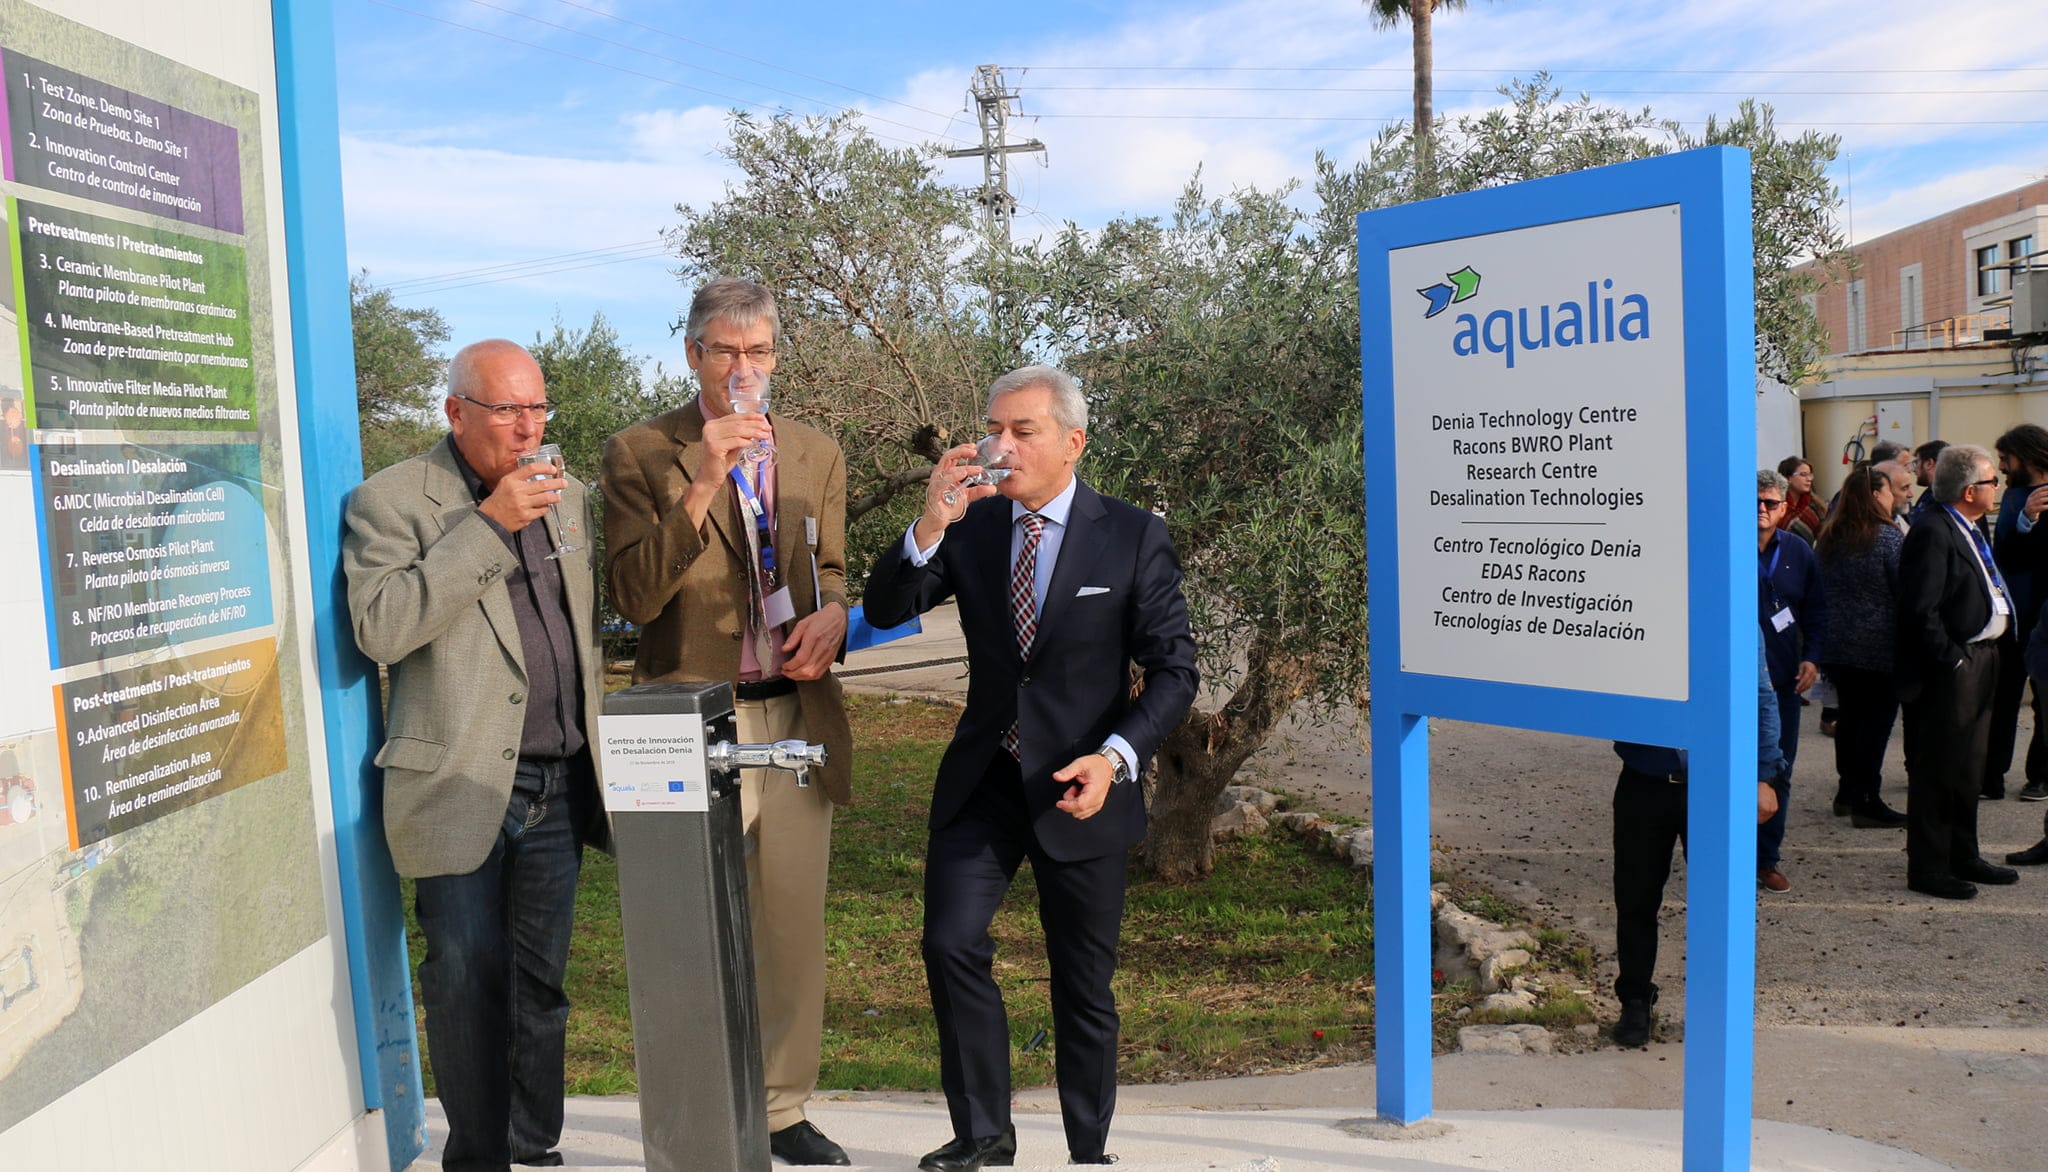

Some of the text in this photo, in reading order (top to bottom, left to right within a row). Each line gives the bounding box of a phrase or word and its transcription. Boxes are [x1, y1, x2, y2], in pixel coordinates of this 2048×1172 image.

[24, 73, 160, 129] 1. Test Zone. Demo Site 1
[43, 102, 188, 159] Zona de Pruebas. Demo Site 1
[28, 132, 180, 186] 2. Innovation Control Center
[48, 161, 201, 212] Centro de control de innovación
[29, 216, 114, 247] Pretreatments
[123, 237, 203, 265] Pretratamientos
[39, 253, 205, 294] 3. Ceramic Membrane Pilot Plant
[59, 280, 236, 319] Planta piloto de membranas cerámicas
[45, 313, 234, 347] 4. Membrane-Based Pretreatment Hub
[1452, 278, 1650, 368] aqualia
[63, 338, 248, 369] Zona de pre-tratamiento por membranas
[51, 376, 227, 399] 5. Innovative Filter Media Pilot Plant
[69, 400, 250, 420] Planta piloto de nuevos medios filtrantes
[1432, 406, 1637, 430] Denia Technology Centre
[1453, 434, 1613, 455] Racons BWRO Plant
[51, 460, 124, 477] Desalination
[132, 458, 187, 474] Desalación
[1467, 462, 1597, 480] Research Centre
[94, 490, 145, 511] (Microbial
[147, 488, 204, 505] Desalination
[206, 486, 225, 502] Cell)
[1430, 488, 1644, 510] Desalination Technologies
[80, 509, 225, 533] Celda de desalación microbiana
[67, 540, 214, 568] 7. Reverse Osmosis Pilot Plant
[1434, 536, 1641, 559] Centro Tecnológico Denia
[85, 559, 229, 590] Planta piloto de ósmosis inversa
[1481, 564, 1585, 583] EDAS Racons
[72, 585, 251, 626] 8. NF/RO Membrane Recovery Process
[1442, 587, 1633, 614] Centro de Investigación
[90, 604, 246, 647] Procesos de recuperación de NF/RO
[1434, 611, 1645, 641] Tecnologías de Desalación
[74, 679, 162, 713] Post-treatments
[169, 657, 251, 688] Post-tratamientos
[142, 700, 198, 727] Disinfection
[199, 696, 220, 712] Area
[102, 710, 240, 764] Área de desinfección avanzada
[83, 750, 211, 804] 10. Remineralization Area
[109, 767, 221, 819] Área de remineralización
